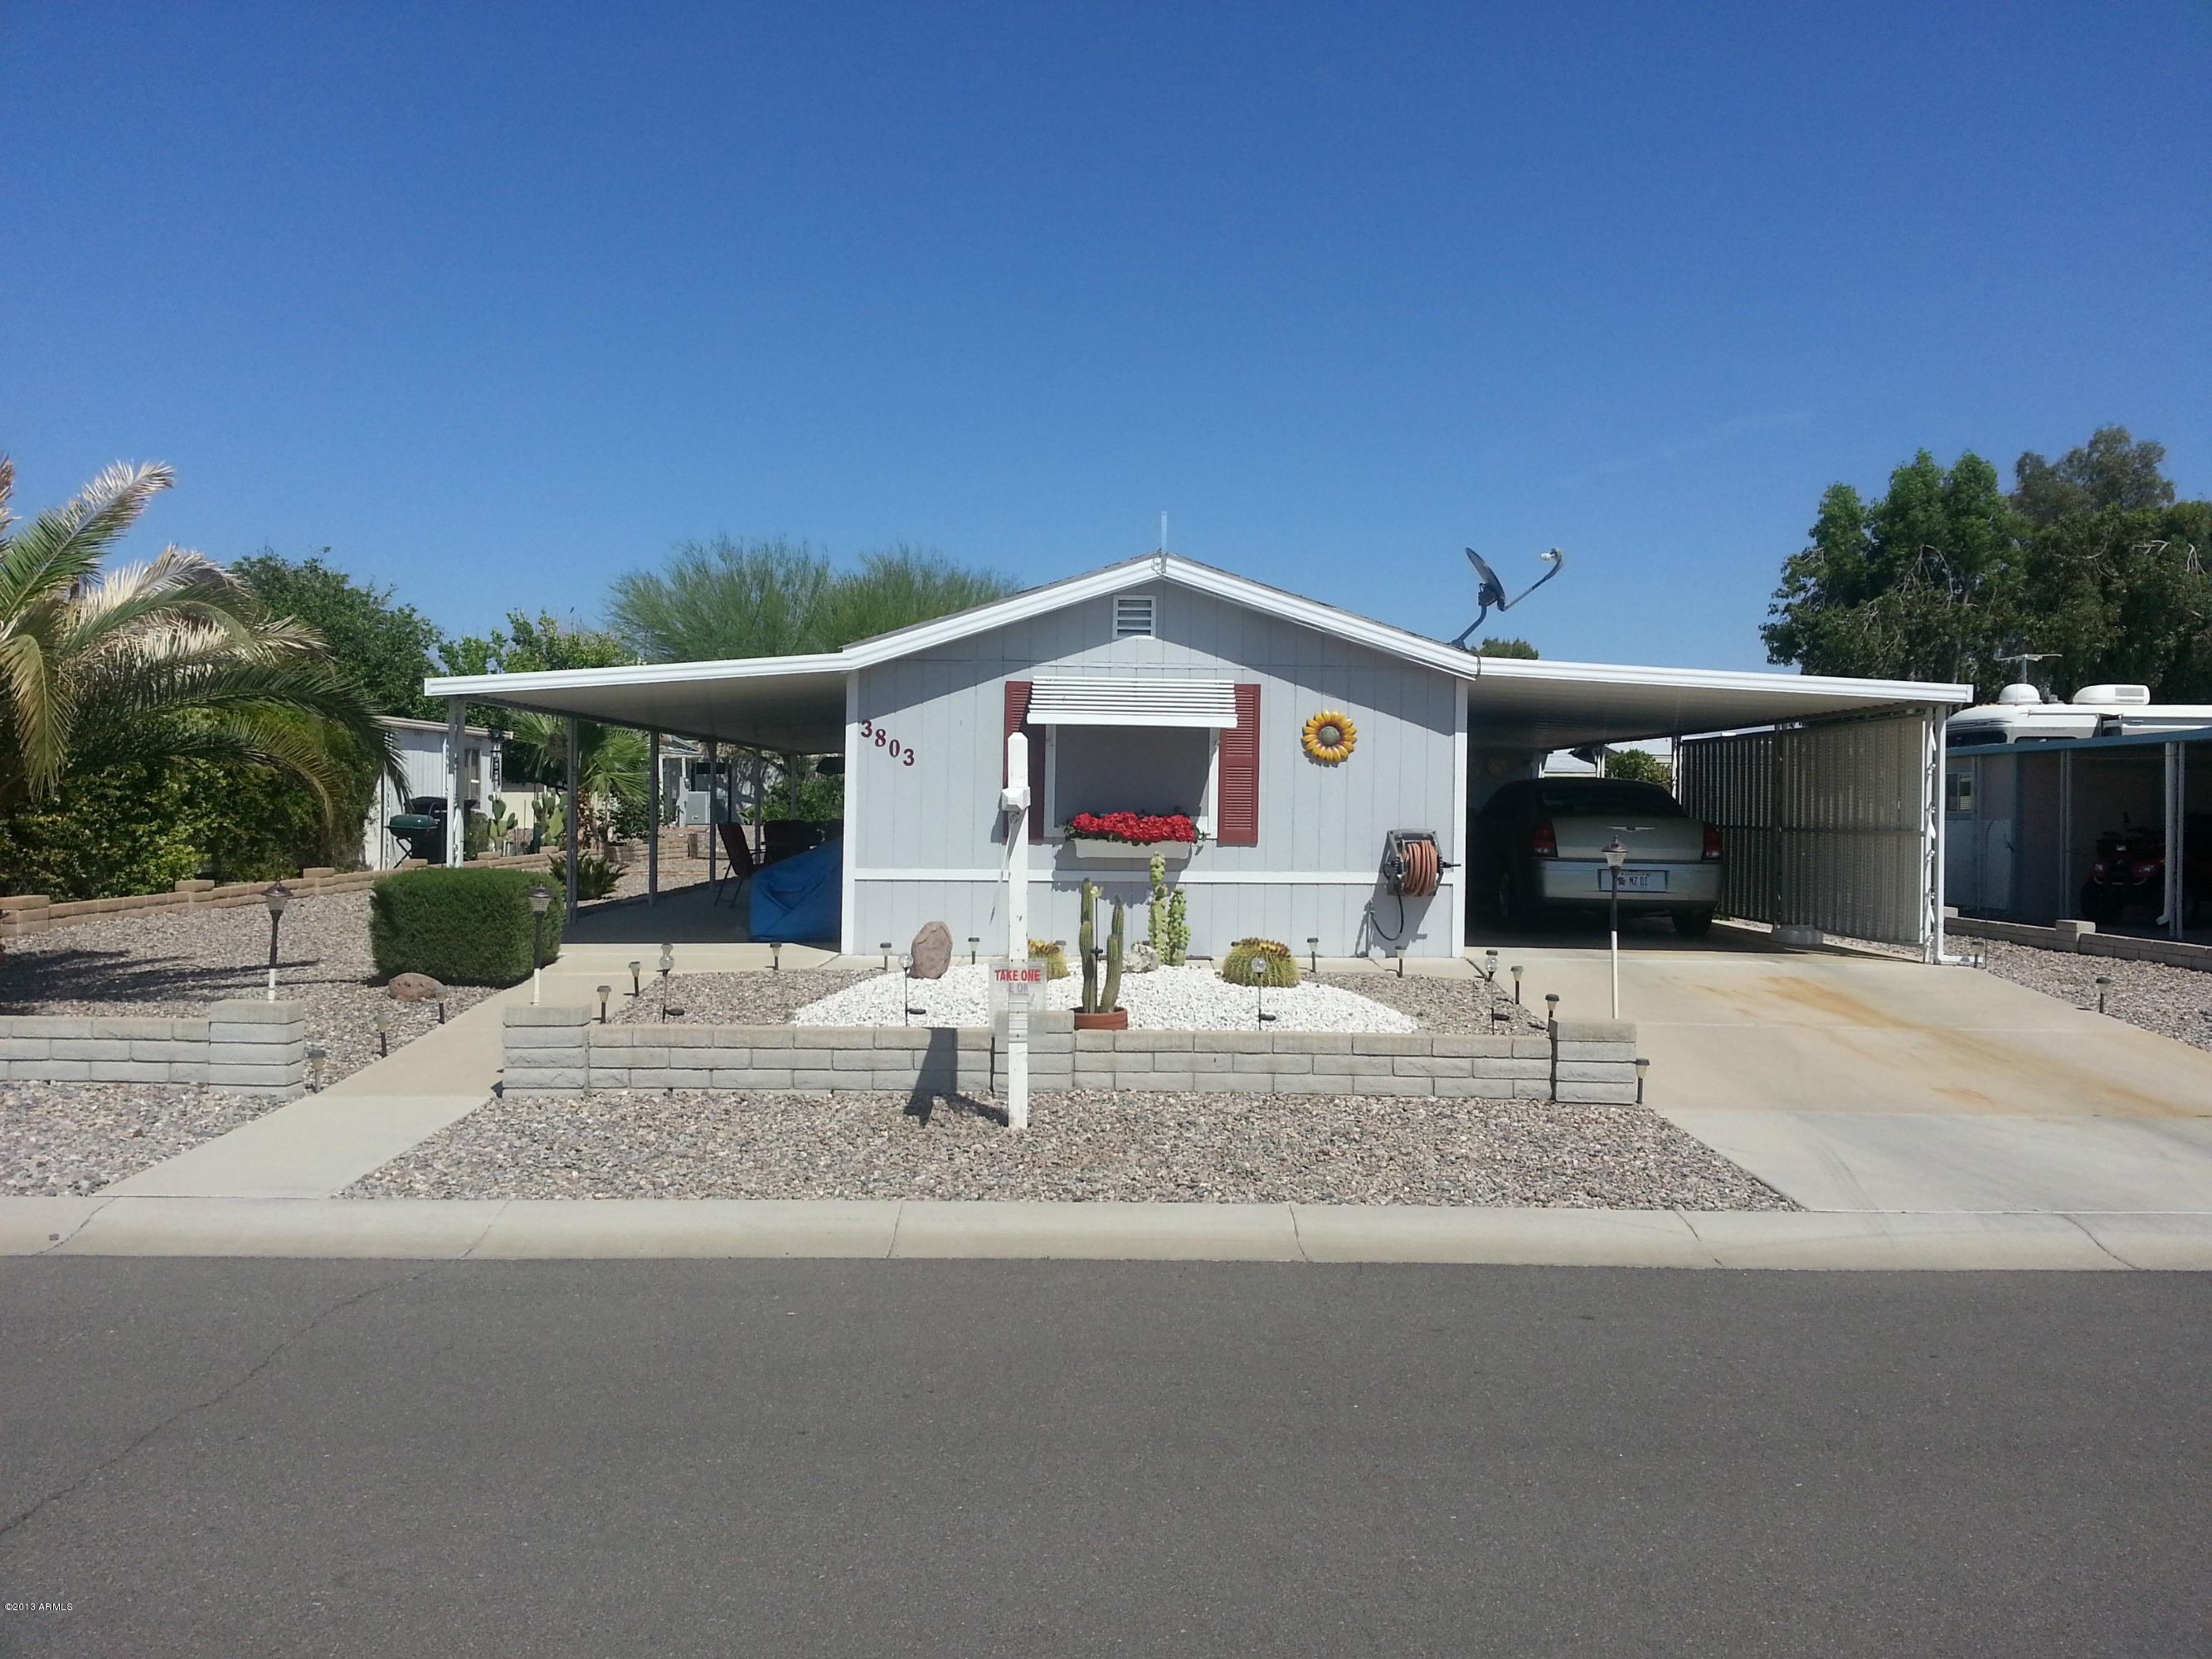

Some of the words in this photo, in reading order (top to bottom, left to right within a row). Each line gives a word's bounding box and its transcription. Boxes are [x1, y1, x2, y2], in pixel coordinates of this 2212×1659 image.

[861, 719, 915, 766] 3803
[995, 969, 1018, 981] TAKE
[1021, 969, 1040, 981] ONE
